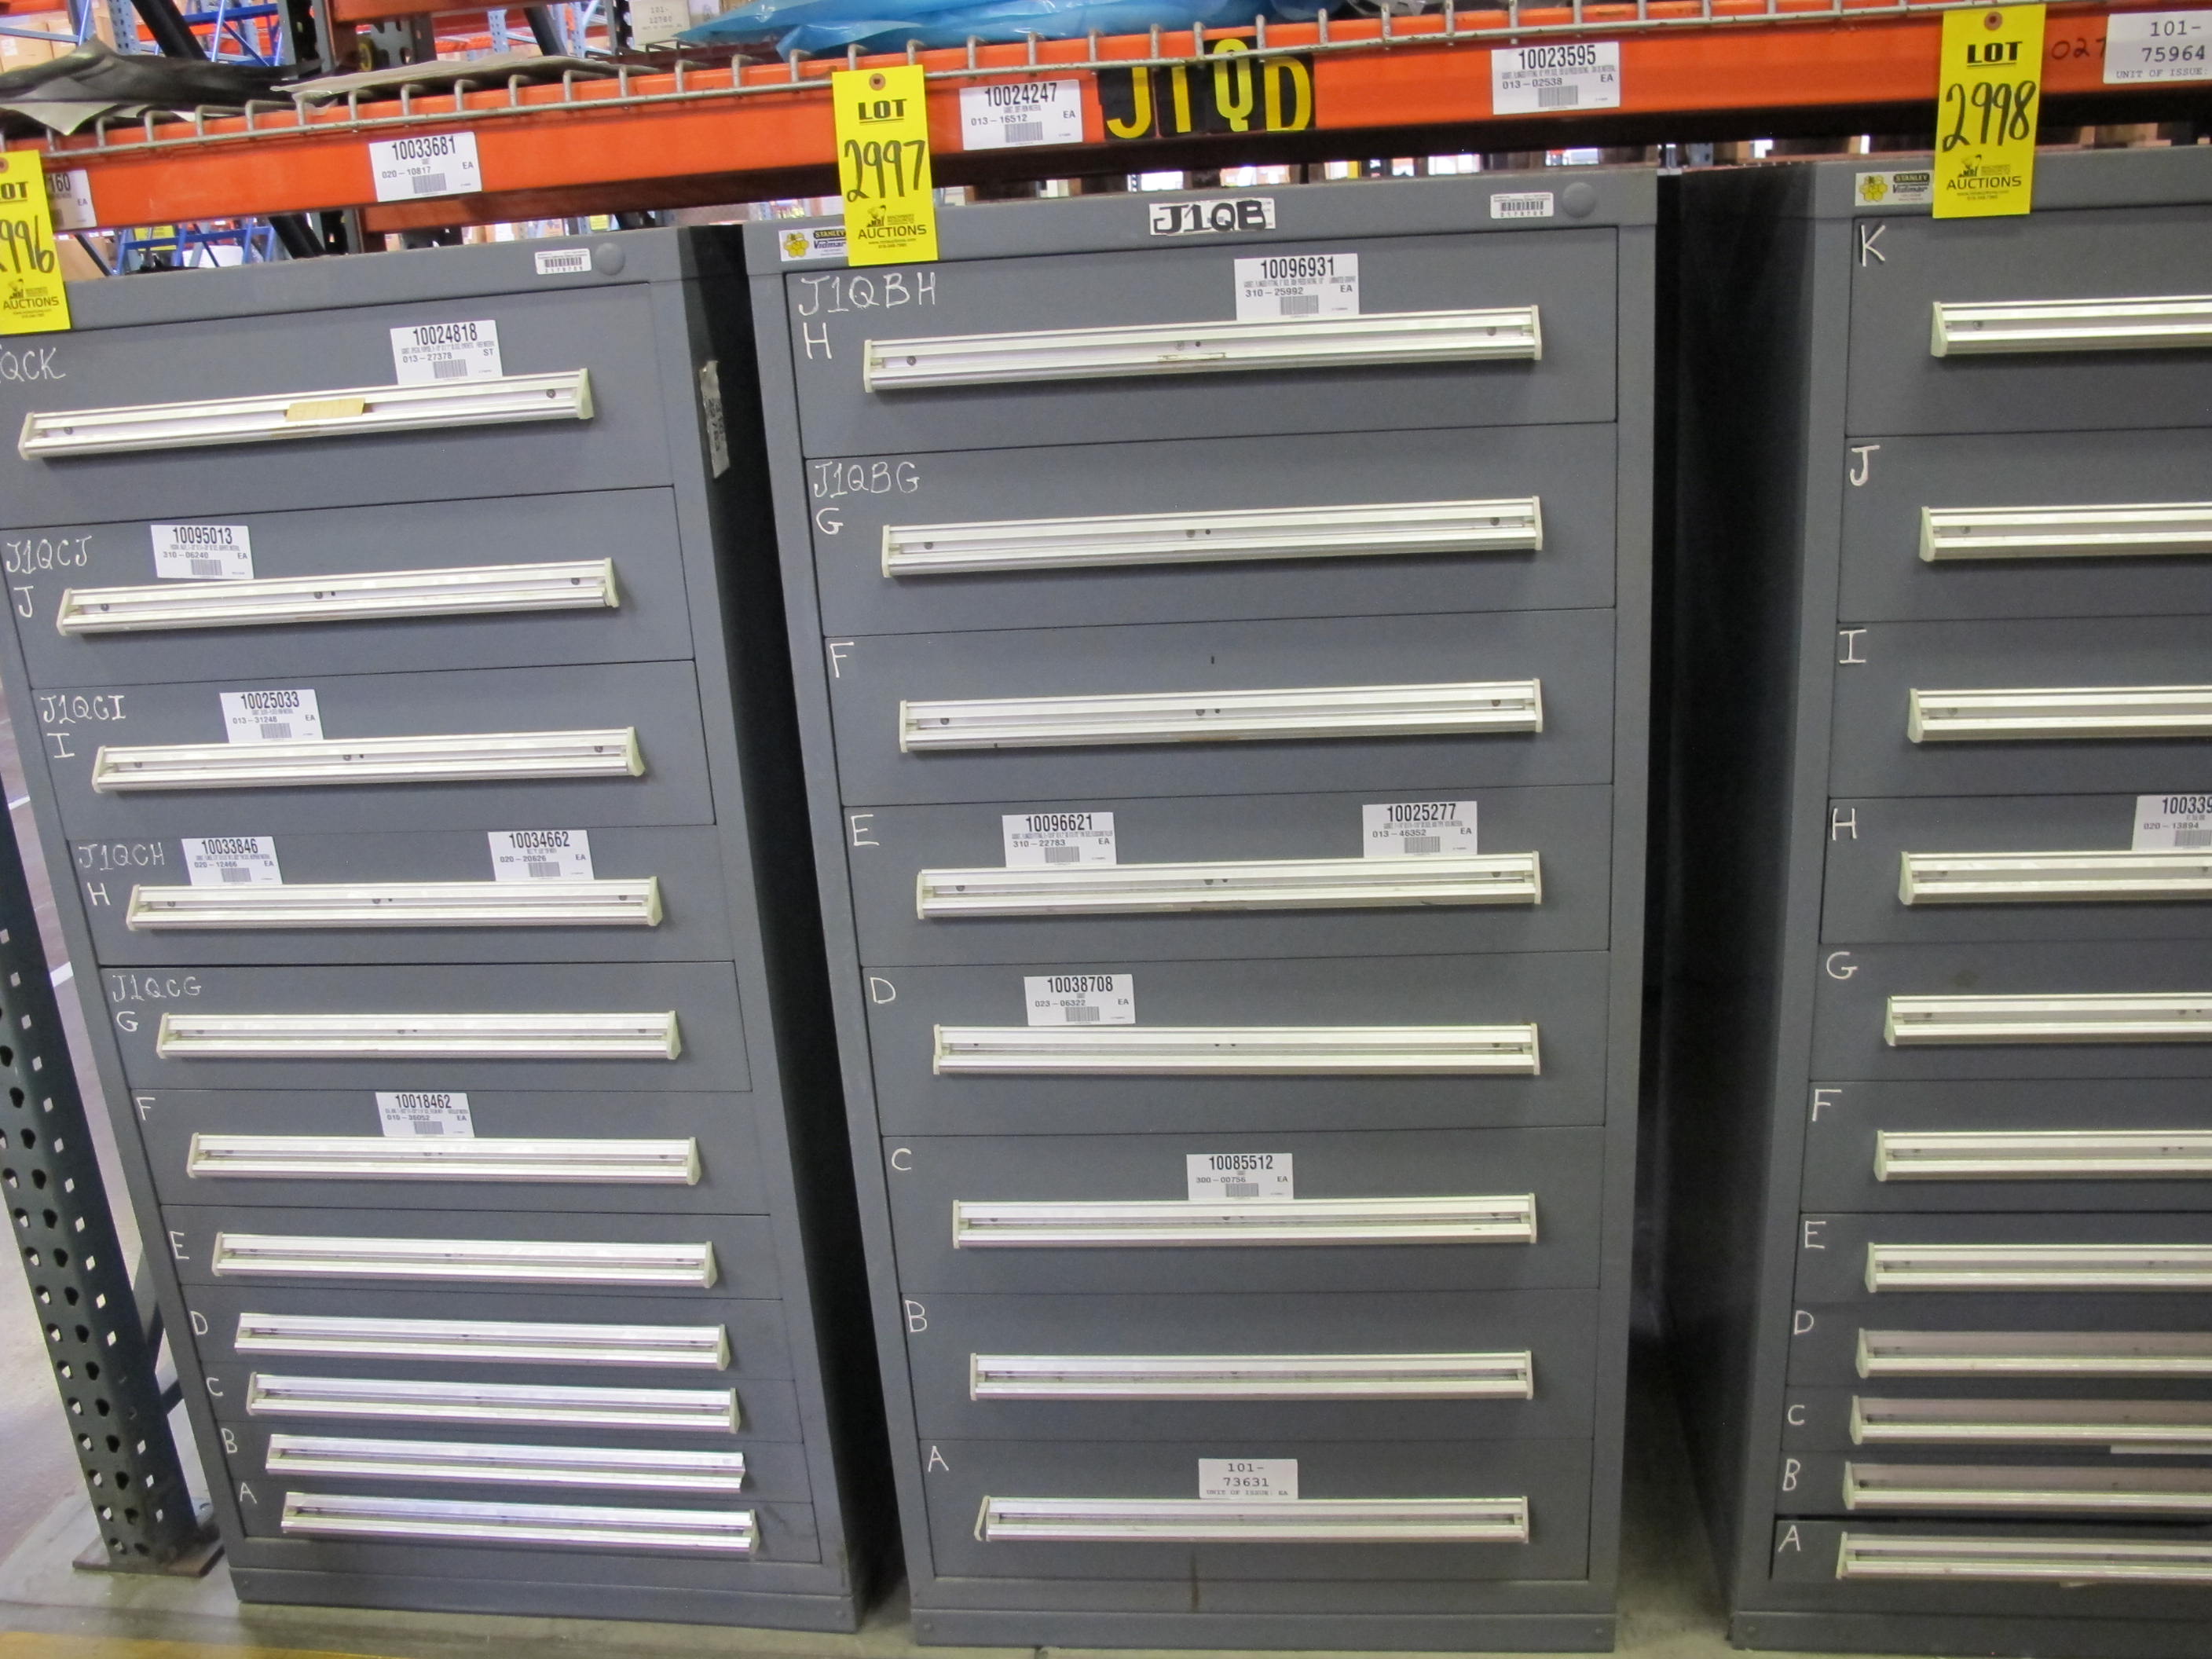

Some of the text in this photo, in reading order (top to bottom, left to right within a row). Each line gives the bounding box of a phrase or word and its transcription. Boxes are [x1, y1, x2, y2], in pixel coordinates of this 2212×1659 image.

[2150, 20, 2201, 37] 101-
[1518, 45, 1596, 70] 10023595
[1967, 41, 2023, 64] LOT
[2141, 44, 2205, 63] 75964
[1600, 74, 1613, 82] EA
[2116, 70, 2143, 79] UNIT
[2170, 67, 2208, 76] ISSUE:
[984, 82, 1057, 107] 10024247
[1106, 38, 1312, 139] J1QD
[858, 99, 907, 121] LOT
[1943, 80, 2036, 152] 2998
[391, 135, 456, 161] 10033681
[844, 139, 926, 203] 2997
[1946, 176, 2022, 190] AUCTIONS
[78, 198, 88, 207] EA
[1153, 200, 1266, 234] J1QB
[0, 214, 55, 274] 996
[815, 229, 845, 238] STANLEY
[857, 224, 927, 240] AUCTIONS
[1860, 225, 1885, 267] K
[1260, 256, 1335, 279] 10096931
[3, 296, 60, 310] AUCTIONS
[798, 272, 936, 316] J1QBH
[412, 323, 478, 346] 10024818
[803, 322, 832, 359] H
[0, 344, 66, 383] QCK
[1849, 445, 1881, 486] J
[814, 461, 920, 498] J1QBG
[815, 507, 844, 535] G
[172, 526, 233, 544] 10095013
[5, 535, 92, 574] J1QCJ
[13, 585, 35, 618] J
[830, 641, 854, 678] F
[1839, 629, 1867, 665] I
[240, 691, 300, 709] 10025033
[46, 733, 75, 759] I
[1025, 814, 1093, 832] 10096621
[1386, 804, 1456, 822] 10025277
[1832, 808, 1857, 840] H
[508, 831, 570, 848] 10034662
[851, 814, 880, 846] E
[78, 842, 166, 871] J1QCH
[201, 838, 258, 855] 10033846
[86, 881, 112, 906] H
[1826, 951, 1858, 980] G
[112, 974, 202, 1002] J1QCG
[870, 976, 896, 1004] D
[1047, 976, 1113, 993] 10038708
[116, 1010, 138, 1032] G
[136, 1097, 156, 1121] F
[395, 1093, 452, 1108] 10018462
[1811, 1089, 1842, 1122] F
[891, 1148, 912, 1171] C
[1209, 1155, 1273, 1170] 10085512
[168, 1231, 189, 1260] E
[1804, 1220, 1826, 1250] E
[190, 1311, 208, 1335] D
[905, 1299, 928, 1332] B
[1794, 1309, 1815, 1335] D
[207, 1377, 223, 1397] C
[1787, 1404, 1805, 1426] C
[220, 1427, 238, 1453] B
[928, 1445, 949, 1472] A
[1227, 1463, 1264, 1472] 101-
[1222, 1477, 1270, 1487] 73631
[1782, 1458, 1801, 1491] B
[239, 1482, 258, 1504] A
[1778, 1525, 1801, 1552] A
